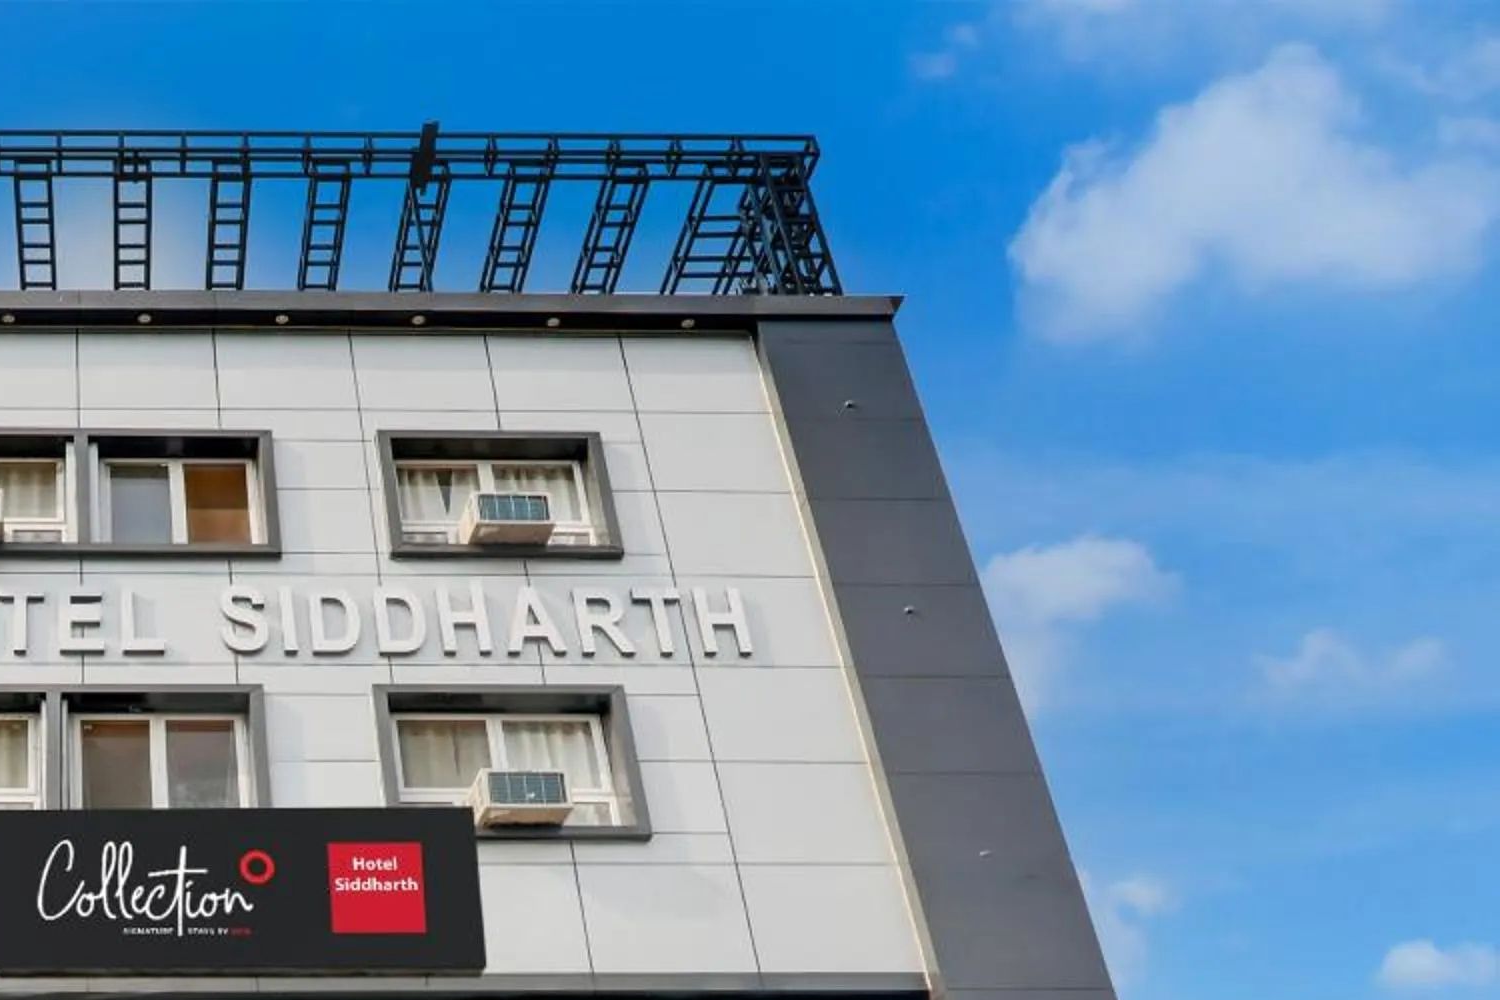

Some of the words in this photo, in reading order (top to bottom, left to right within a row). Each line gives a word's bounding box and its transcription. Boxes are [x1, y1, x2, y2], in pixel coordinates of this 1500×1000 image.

[217, 582, 755, 658] SIDDHARTH
[334, 877, 419, 891] Siddharth
[352, 856, 399, 871] Hotel
[37, 839, 254, 938] Collection
